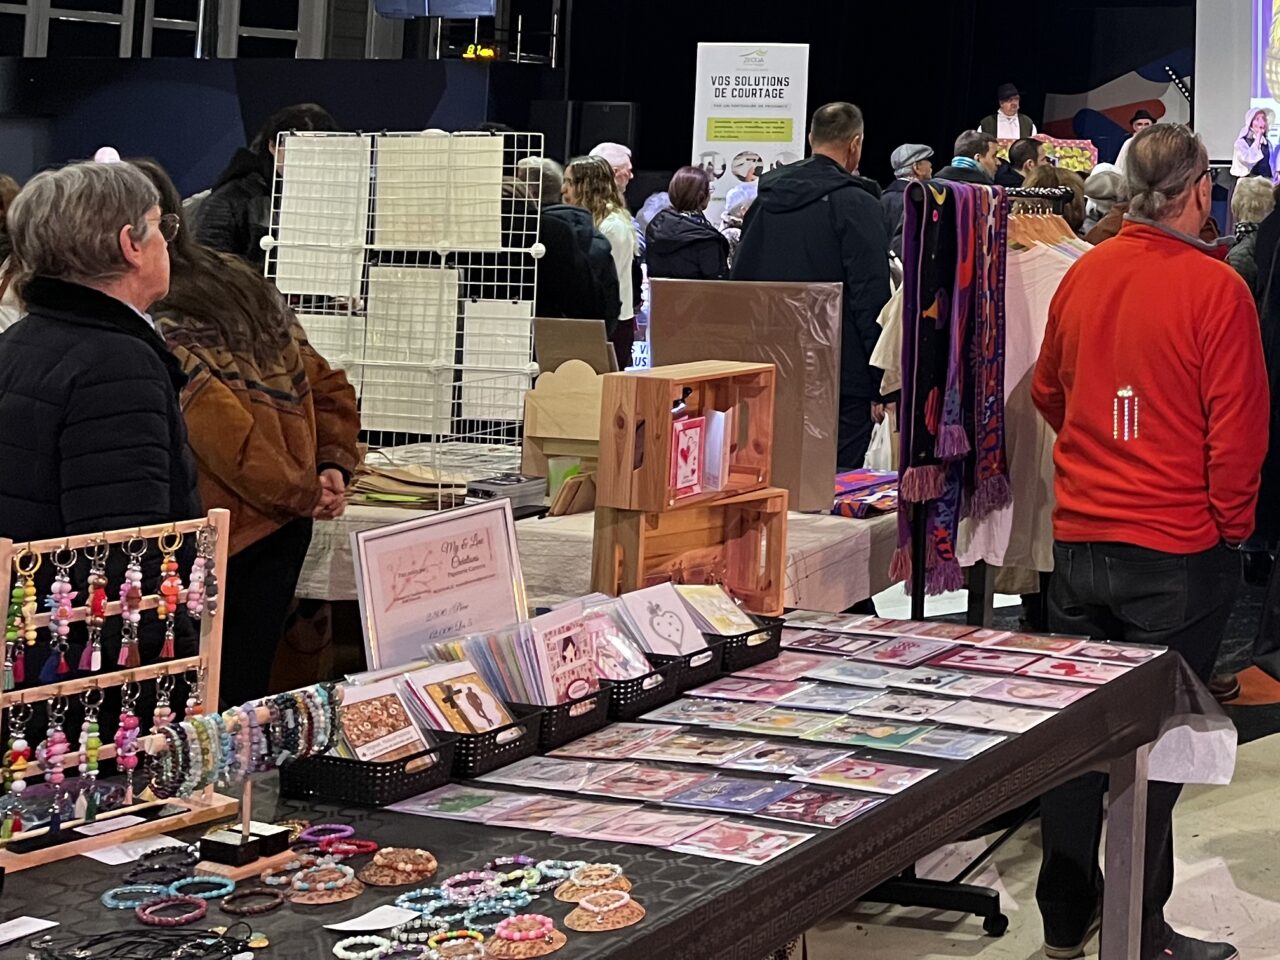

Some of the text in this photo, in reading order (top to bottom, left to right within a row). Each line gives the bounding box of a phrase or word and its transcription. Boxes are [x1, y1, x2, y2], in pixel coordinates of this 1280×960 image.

[710, 76, 790, 87] VOS SOLUTIONS
[714, 87, 785, 99] DE COURTAGE
